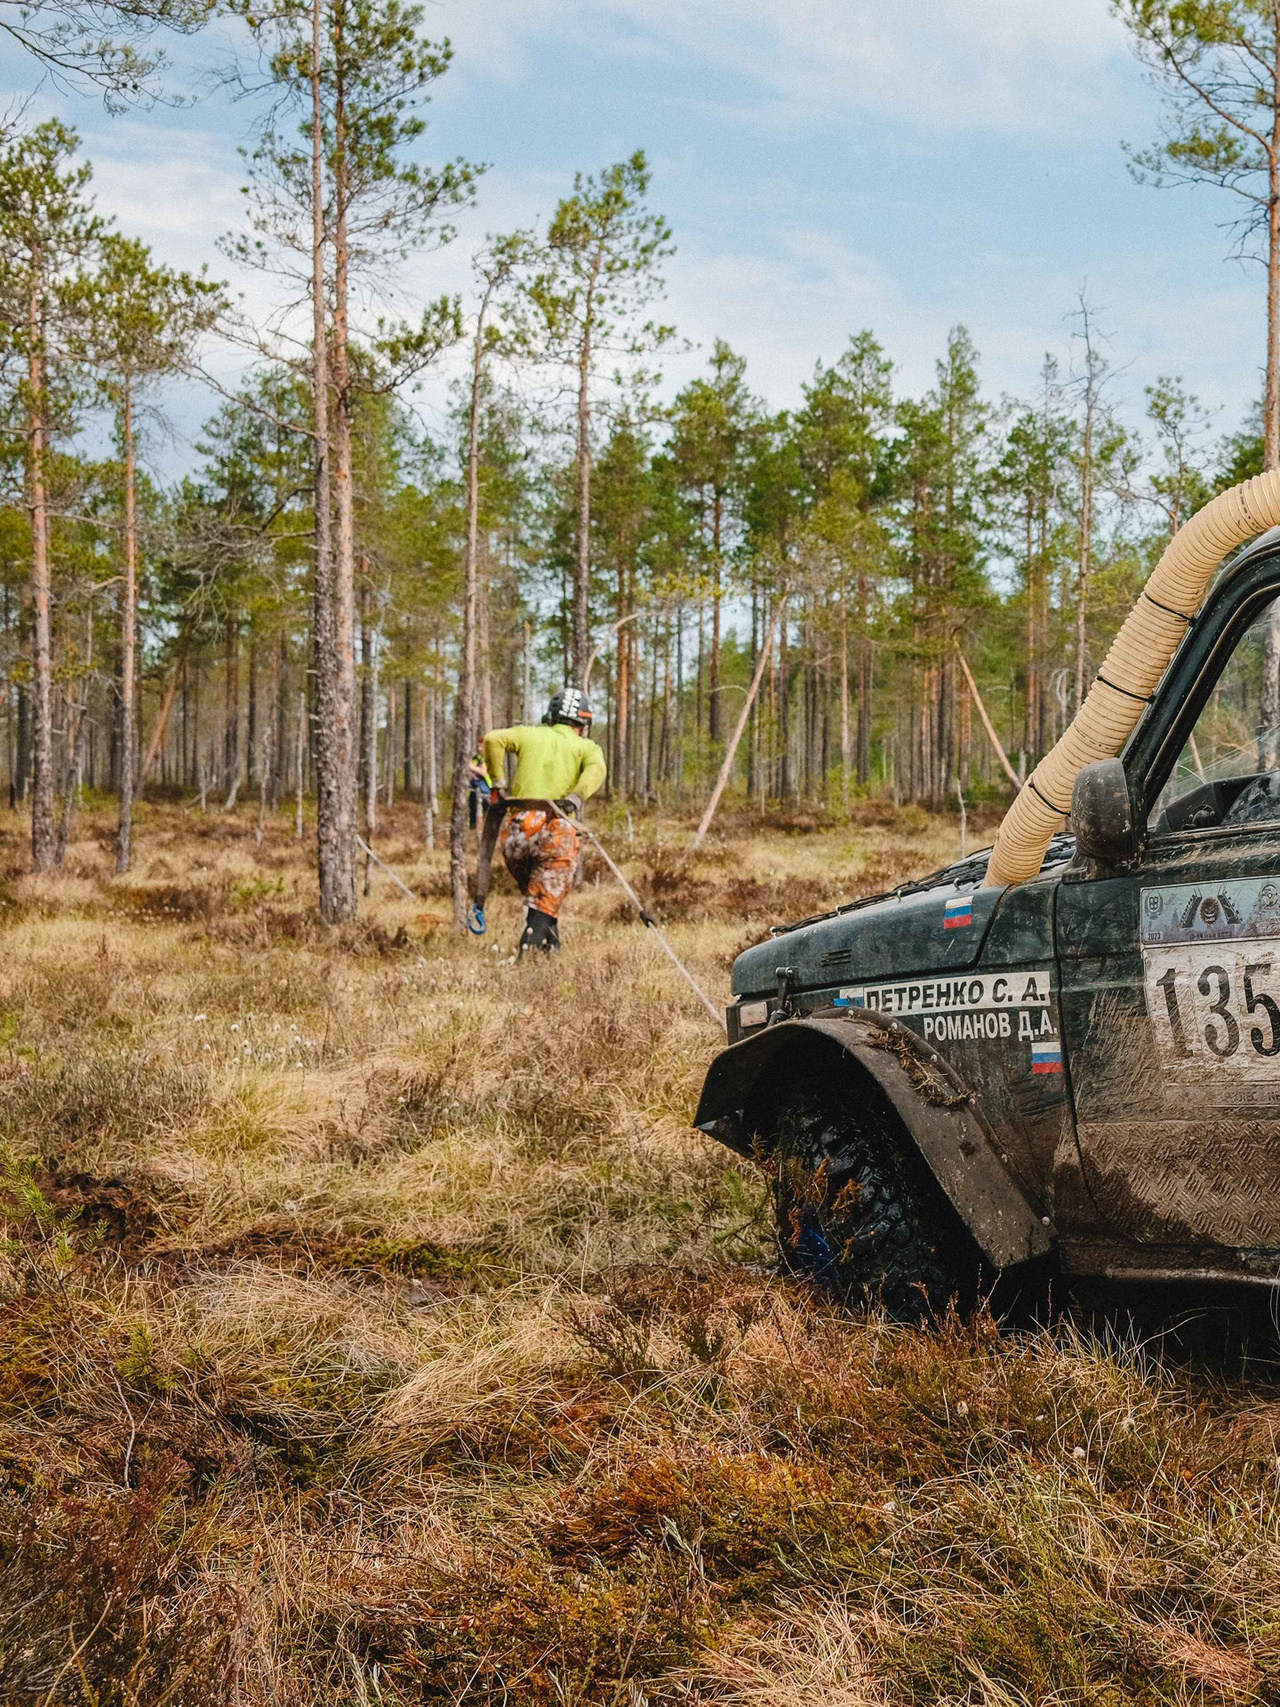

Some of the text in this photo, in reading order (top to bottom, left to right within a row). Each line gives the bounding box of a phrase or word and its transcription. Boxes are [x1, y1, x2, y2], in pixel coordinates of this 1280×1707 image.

[1147, 932, 1160, 941] 2023
[866, 977, 1046, 1012] ПЕТРЕНКО С. А.
[924, 1009, 1058, 1042] РОМАНОВ Д.А.
